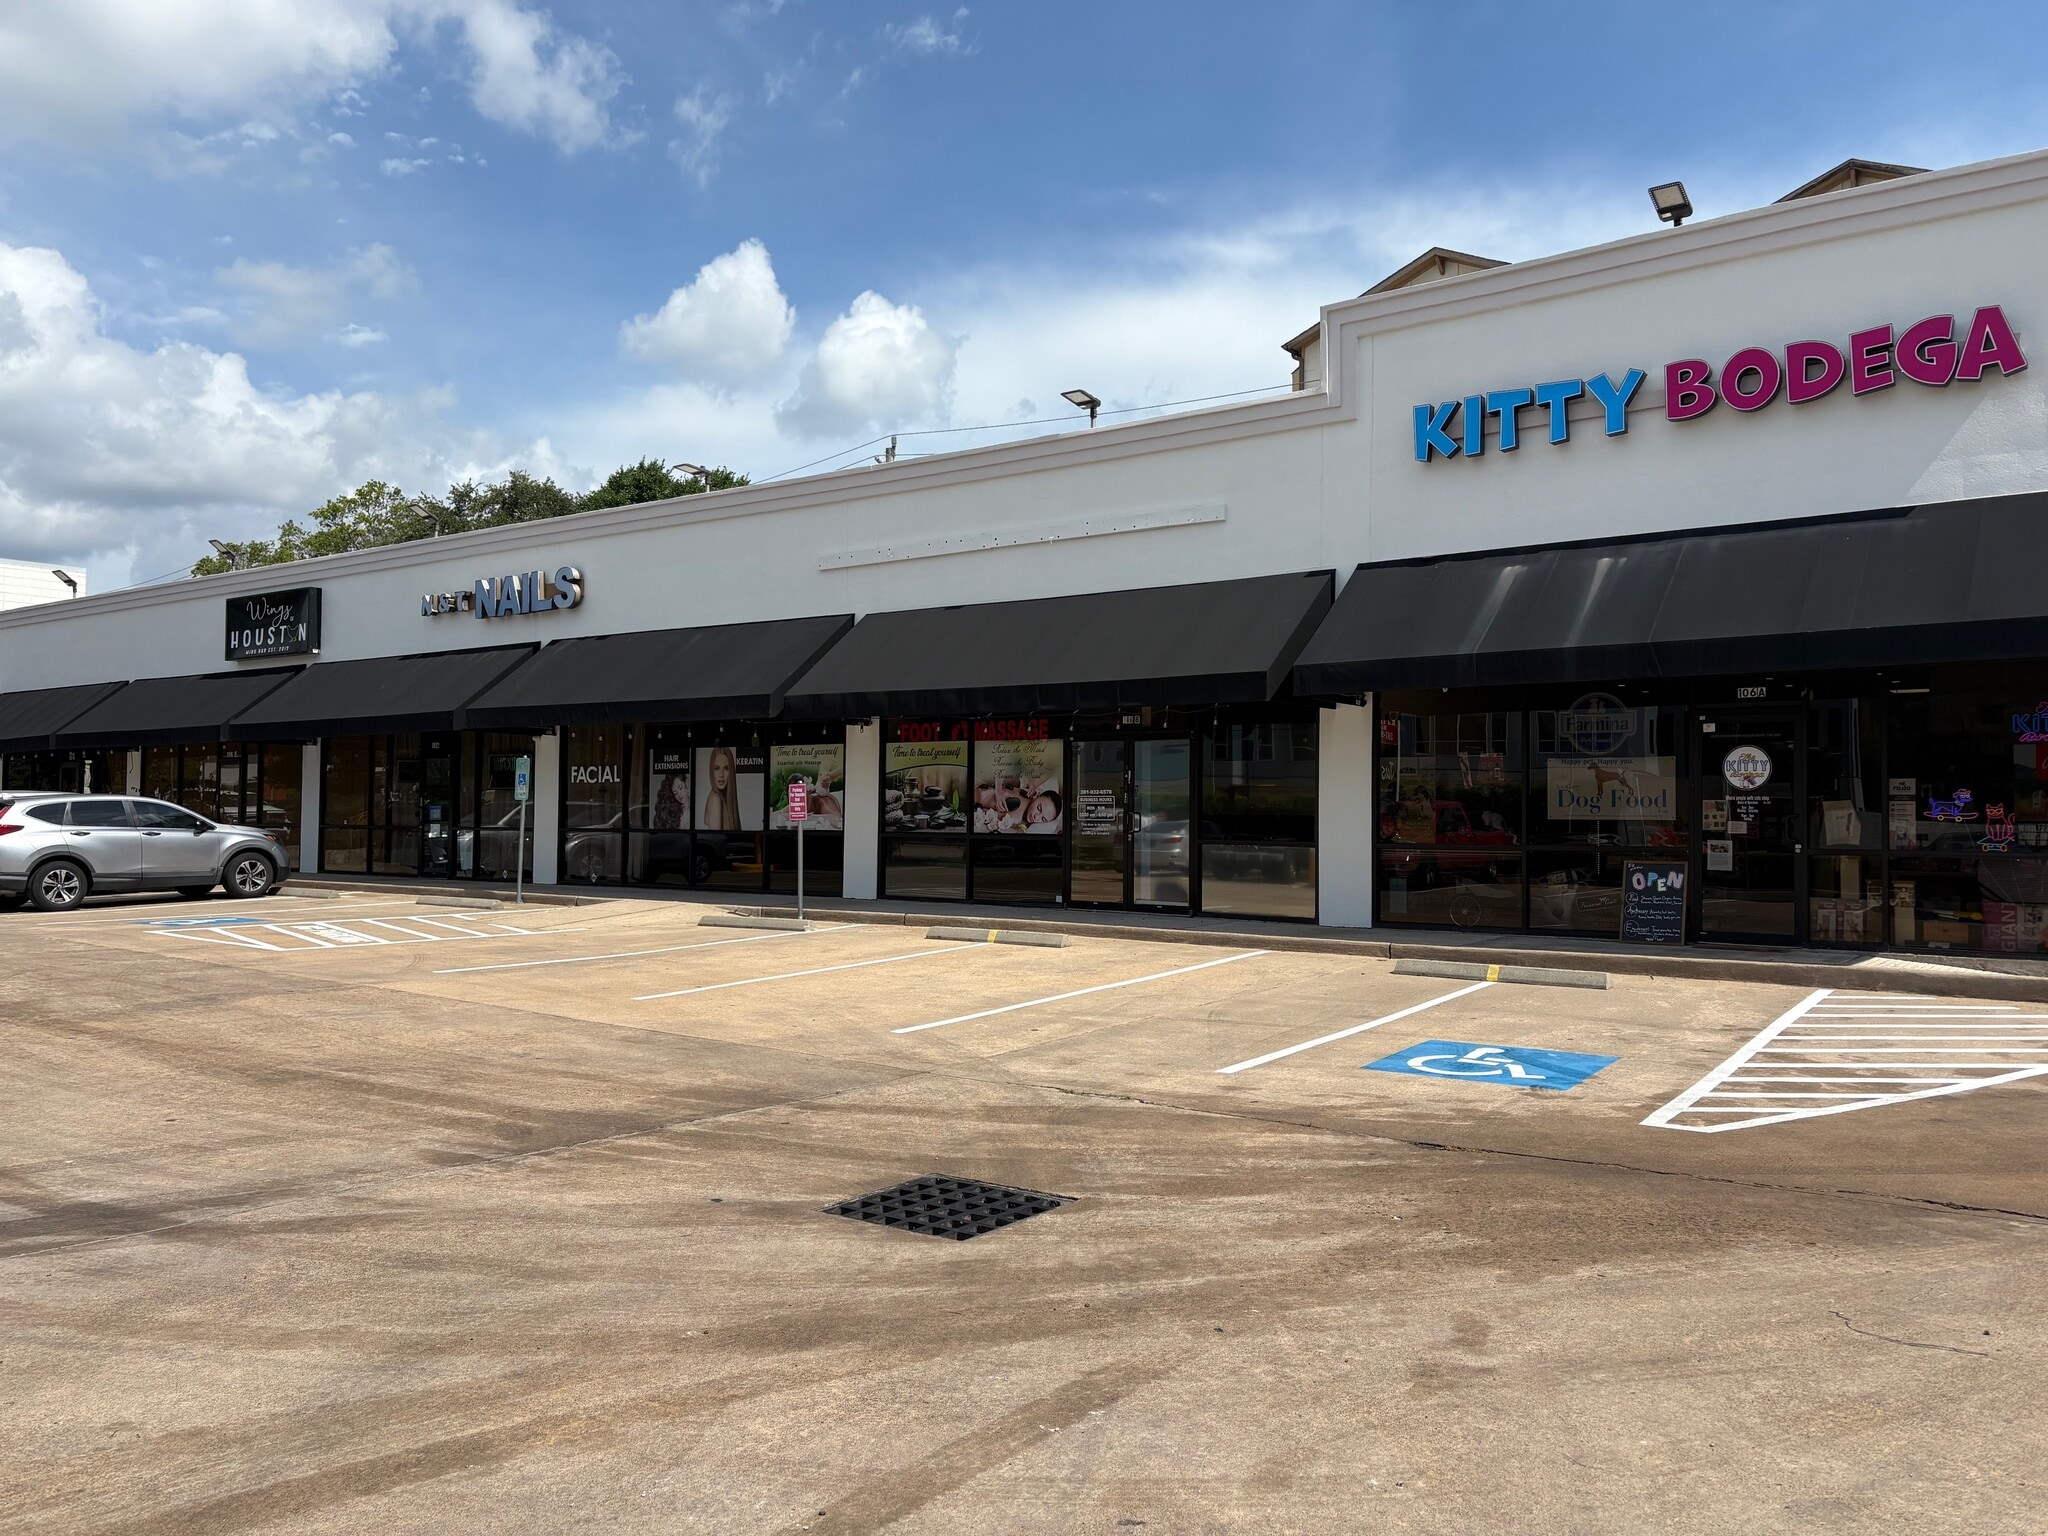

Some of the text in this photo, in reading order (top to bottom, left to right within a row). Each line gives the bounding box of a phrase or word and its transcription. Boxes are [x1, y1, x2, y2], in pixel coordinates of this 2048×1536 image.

[1413, 304, 2028, 463] KITTY BODEGA
[475, 566, 584, 619] NAILS
[246, 597, 293, 628] Wings
[1737, 687, 1766, 698] 106A
[901, 719, 1049, 742] FOOT MASSAGE
[1566, 717, 1629, 732] Farmina
[663, 754, 679, 762] HAIR
[776, 746, 791, 757] Time
[798, 747, 814, 756] treat
[813, 746, 839, 760] yourself
[893, 745, 910, 759] Time
[917, 745, 934, 758] treat
[933, 743, 962, 760] yourself
[736, 757, 764, 766] KERATIN
[571, 765, 621, 784] FACIAL
[1558, 789, 1667, 814] Dog Food
[1632, 871, 1684, 892] OPEN
